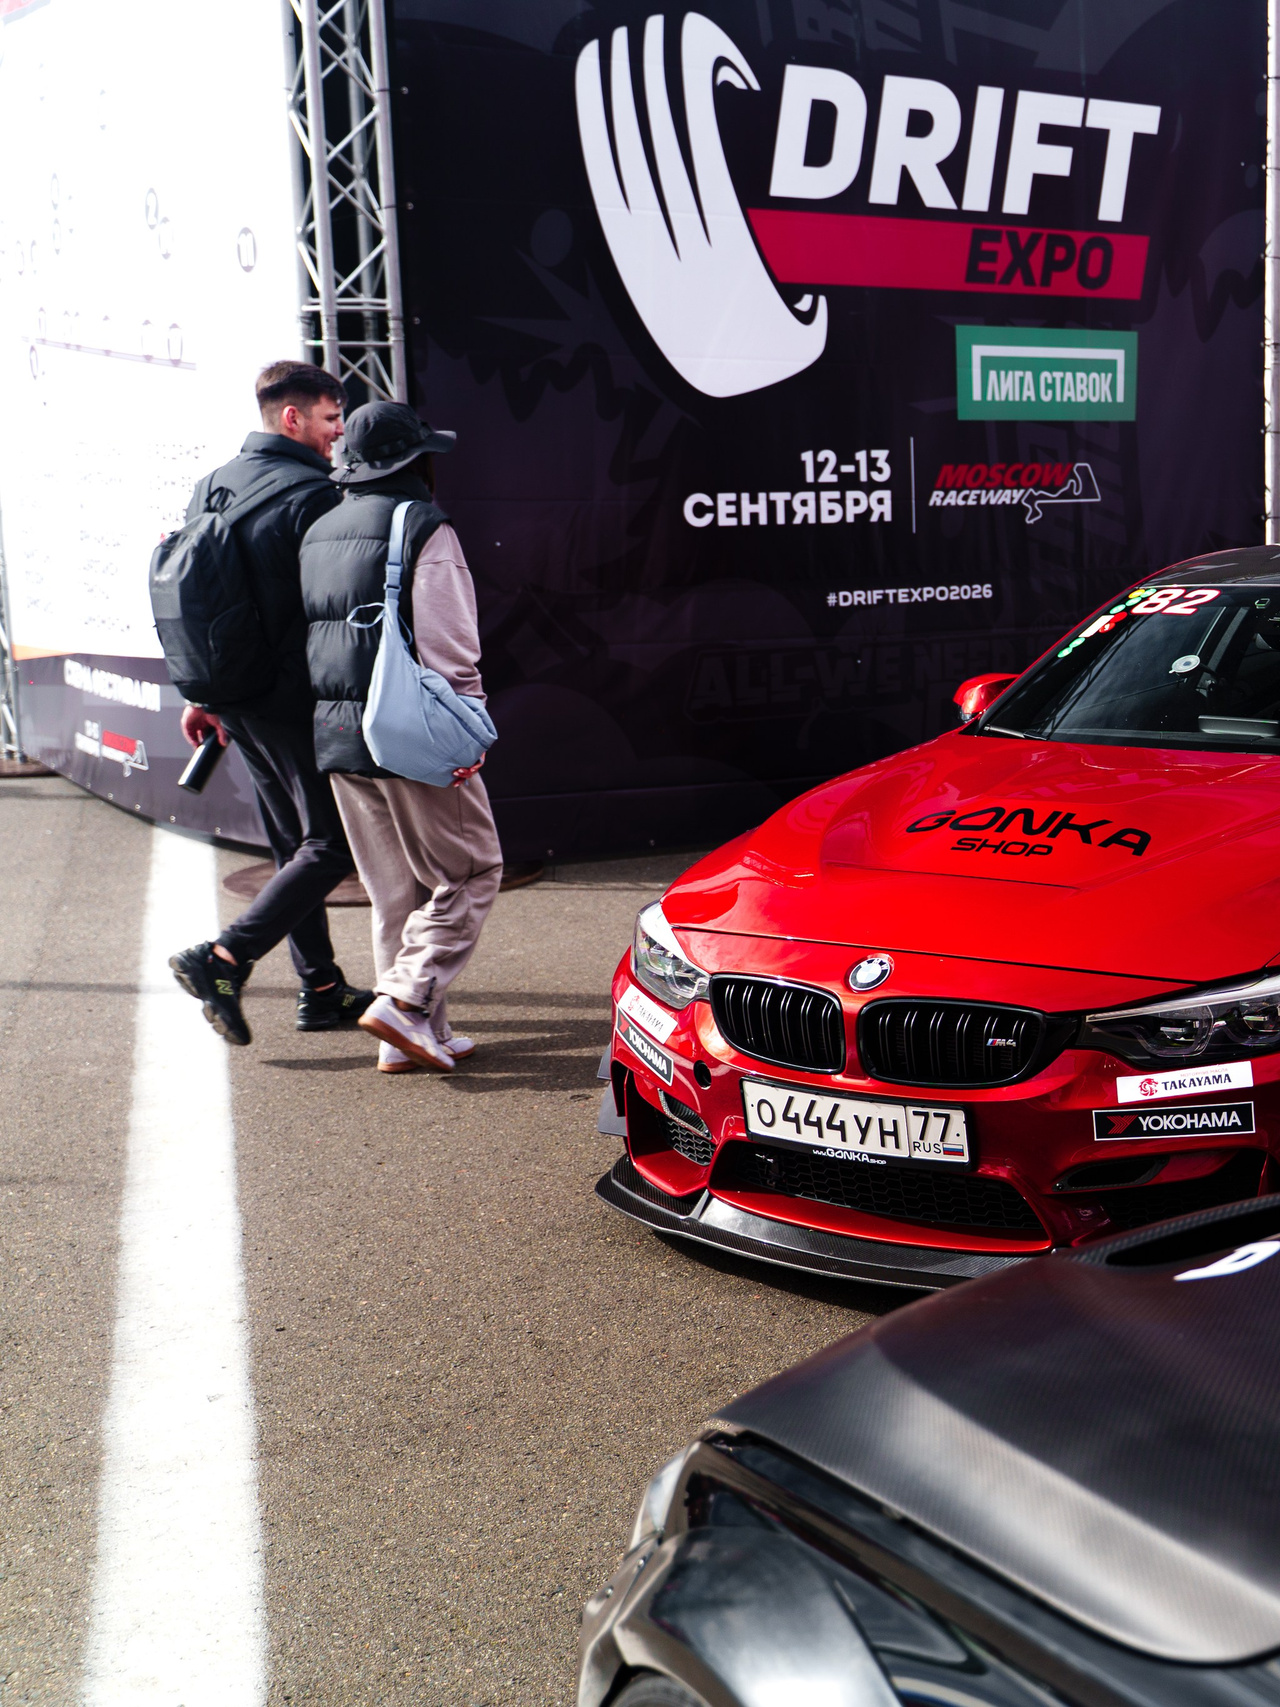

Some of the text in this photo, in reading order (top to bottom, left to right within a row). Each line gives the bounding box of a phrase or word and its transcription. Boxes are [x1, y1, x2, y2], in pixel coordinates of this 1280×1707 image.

[769, 64, 1162, 222] DRIFT
[964, 228, 1114, 290] EXPO
[987, 370, 1113, 403] ЛИГА СТАВОК
[800, 449, 891, 484] 12-13
[934, 463, 1074, 488] MOSCOW
[682, 490, 893, 528] СЕНТЯБРЯ
[928, 489, 1026, 507] RACEWAY
[826, 583, 994, 607] #DRIFTEXPO2026
[1130, 588, 1222, 615] 82
[906, 806, 1152, 857] GONKA
[951, 837, 1054, 857] SHOP
[628, 1026, 668, 1075] YOKOHAMA
[1161, 1073, 1232, 1091] TAKAYAMA
[912, 1111, 951, 1142] 77
[1138, 1111, 1242, 1131] YOKOHAMA
[912, 1141, 942, 1154] RUS
